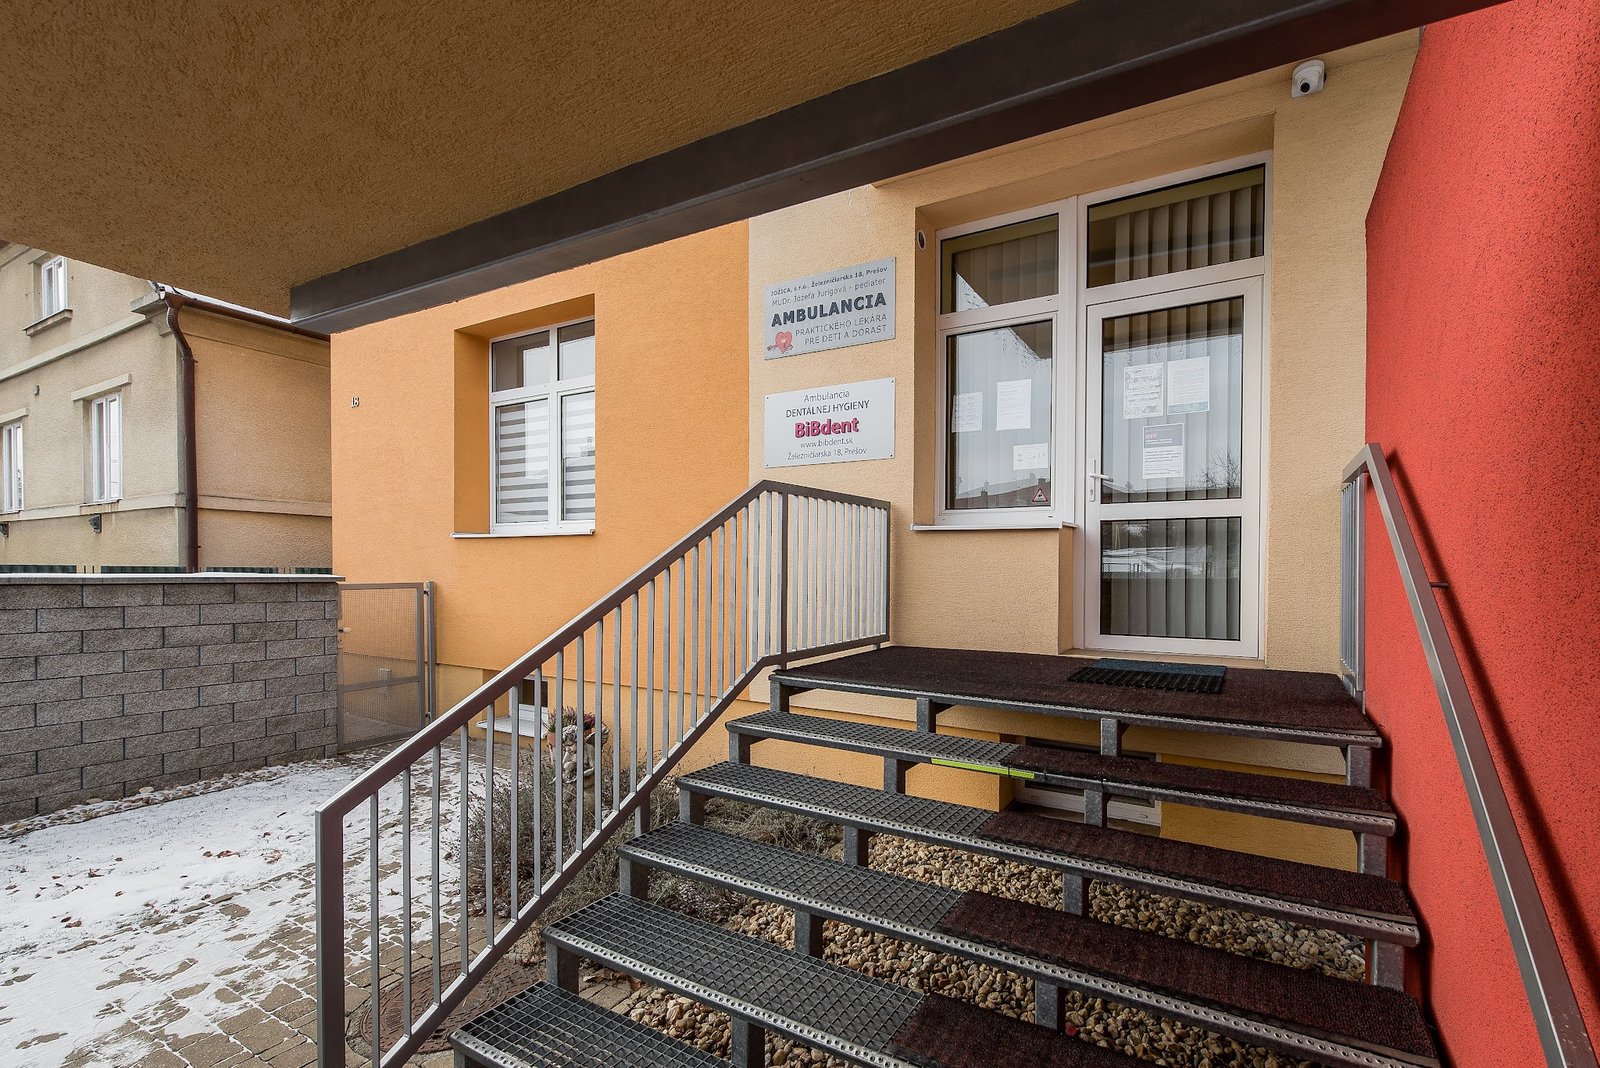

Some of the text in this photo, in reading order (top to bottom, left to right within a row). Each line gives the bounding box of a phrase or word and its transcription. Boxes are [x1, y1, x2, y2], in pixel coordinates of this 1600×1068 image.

[866, 266, 887, 276] Prešov
[794, 292, 814, 303] Jozefa
[817, 286, 846, 297] Jurigová
[855, 278, 886, 290] pediater
[771, 292, 886, 327] AMBULANCIA
[795, 313, 887, 336] PRAKTICKÉHO LEKÁRA
[805, 336, 819, 345] PRE
[822, 332, 841, 342] DETI
[853, 325, 886, 337] DORAST
[804, 390, 850, 402] Ambulancia
[786, 400, 870, 418] DENTÁLNEJ HYGIENY
[795, 417, 859, 438] BiBdent
[800, 437, 853, 449] www.bibdent.sk
[845, 447, 867, 455] Prešov
